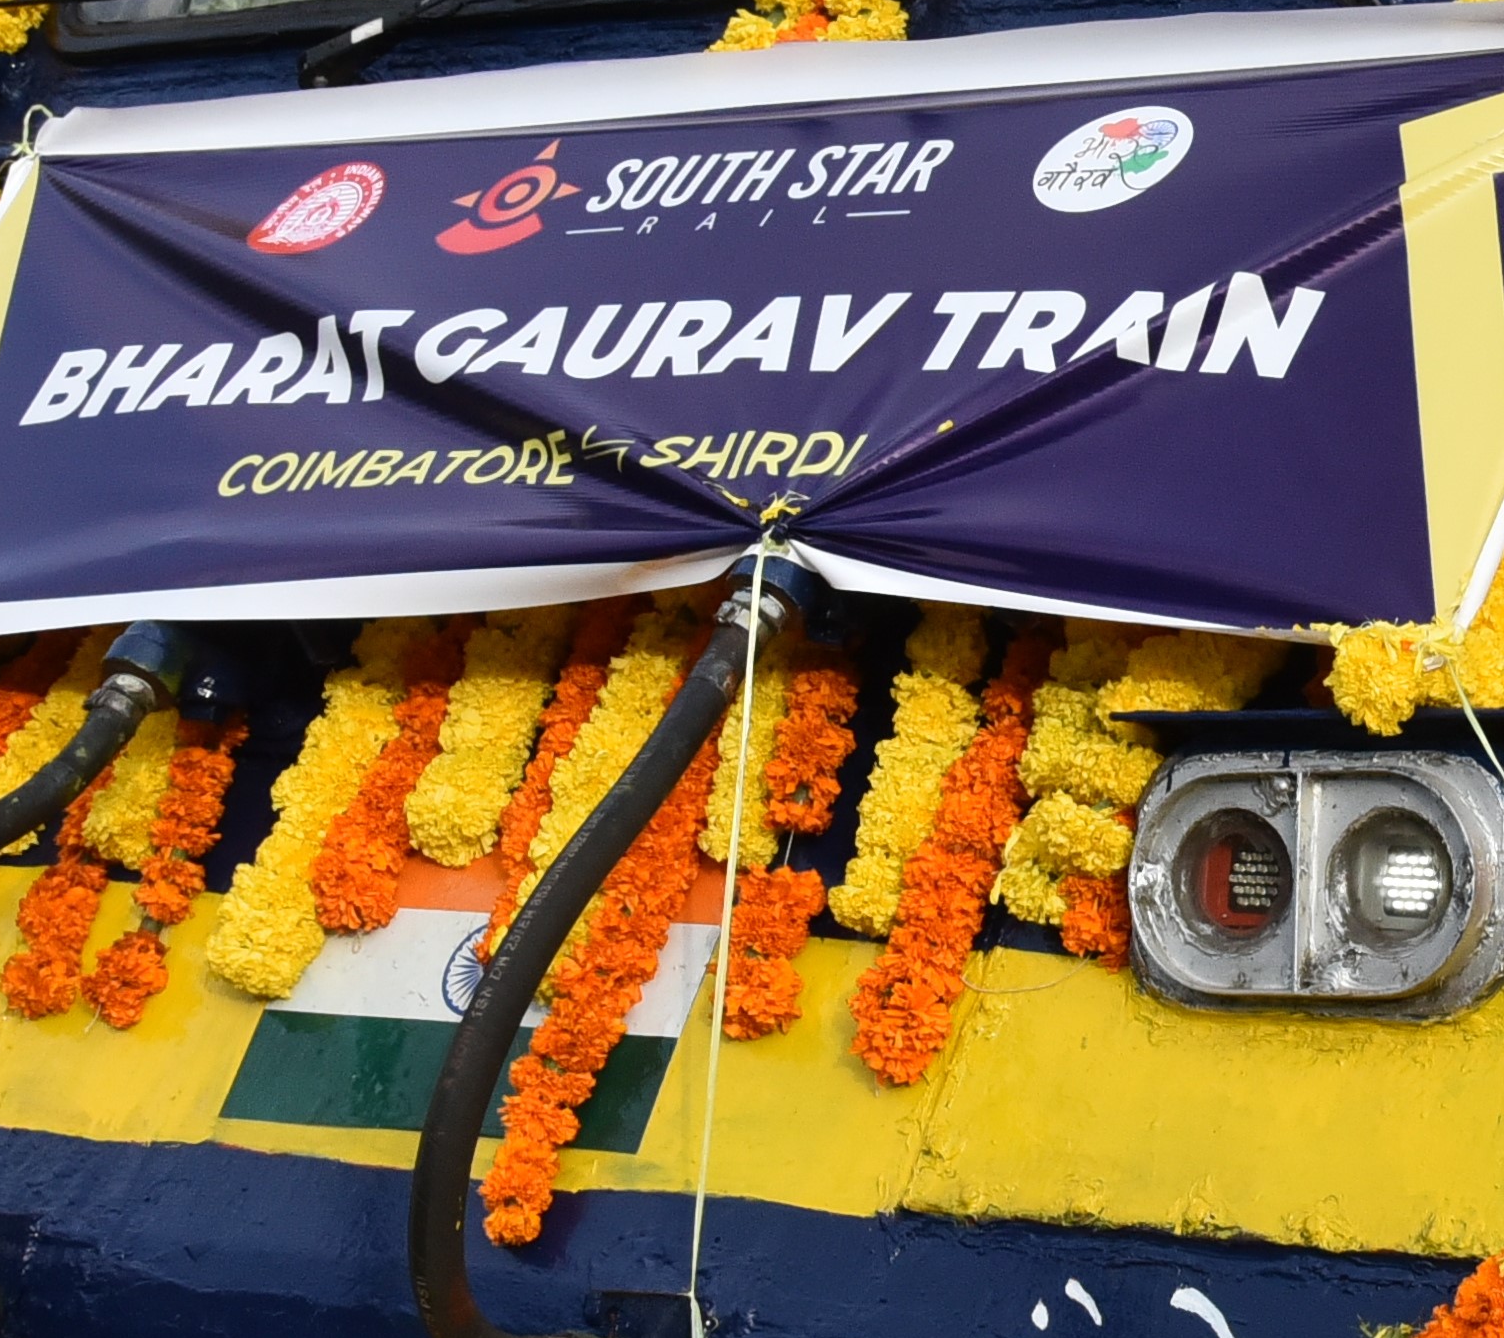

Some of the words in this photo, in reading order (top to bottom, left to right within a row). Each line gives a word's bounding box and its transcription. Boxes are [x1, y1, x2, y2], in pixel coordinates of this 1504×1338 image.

[585, 148, 796, 213] SOUTH
[788, 139, 954, 200] STAR
[1036, 161, 1119, 192] गौरव
[636, 205, 827, 235] RAIL
[19, 308, 415, 427] BHARAT
[414, 291, 914, 384] GAURAV
[922, 271, 1327, 379] TRAIN
[218, 429, 575, 498] COIMBATORE
[640, 429, 869, 479] SHIRDI
